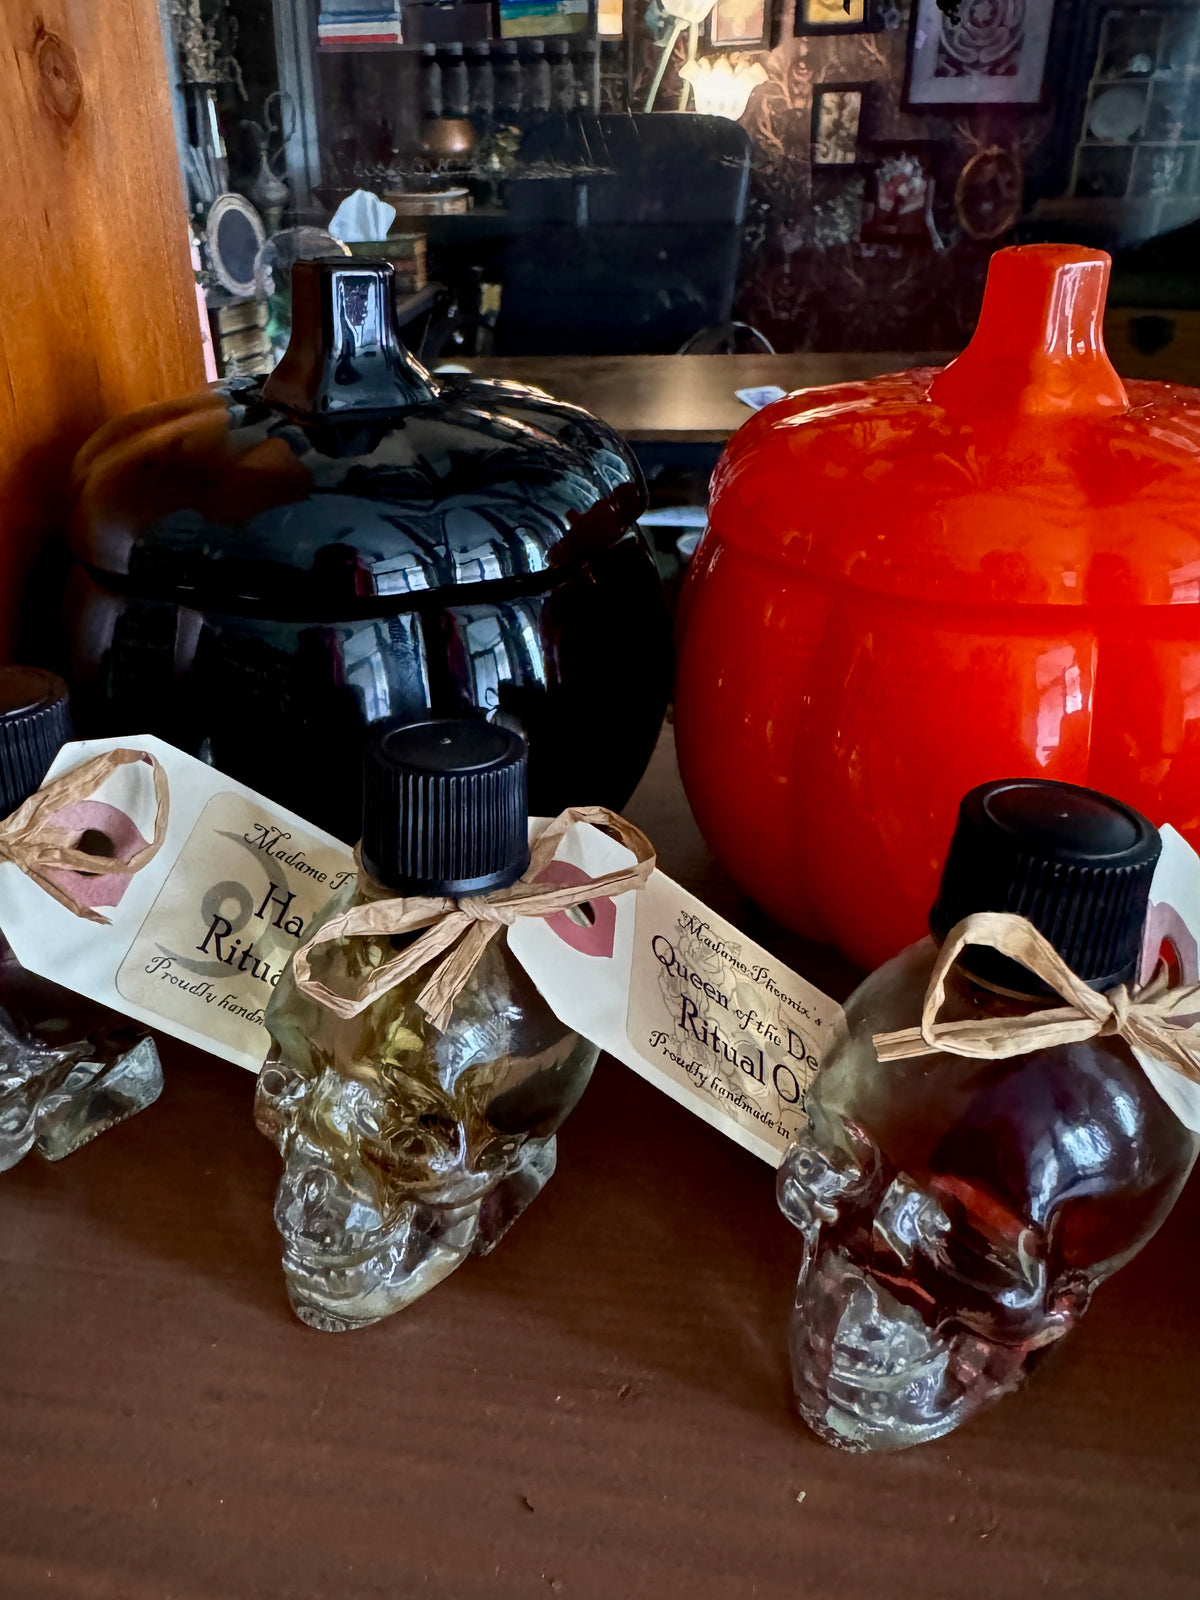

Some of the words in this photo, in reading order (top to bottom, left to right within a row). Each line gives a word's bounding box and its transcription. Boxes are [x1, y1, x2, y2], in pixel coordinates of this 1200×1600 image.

[243, 823, 328, 883] Madame
[254, 881, 304, 939] Ha
[677, 910, 748, 974] Madame
[144, 956, 217, 1004] Proudly
[195, 914, 283, 987] Ritua
[651, 934, 731, 1011] Queen
[735, 1010, 759, 1030] of
[756, 1019, 782, 1046] the
[787, 1027, 819, 1071] De
[649, 1030, 709, 1086] Proudly
[710, 1076, 774, 1129] handmade
[776, 1121, 790, 1140] in
[677, 993, 766, 1086] Ritual
[772, 1063, 808, 1114] Oi
